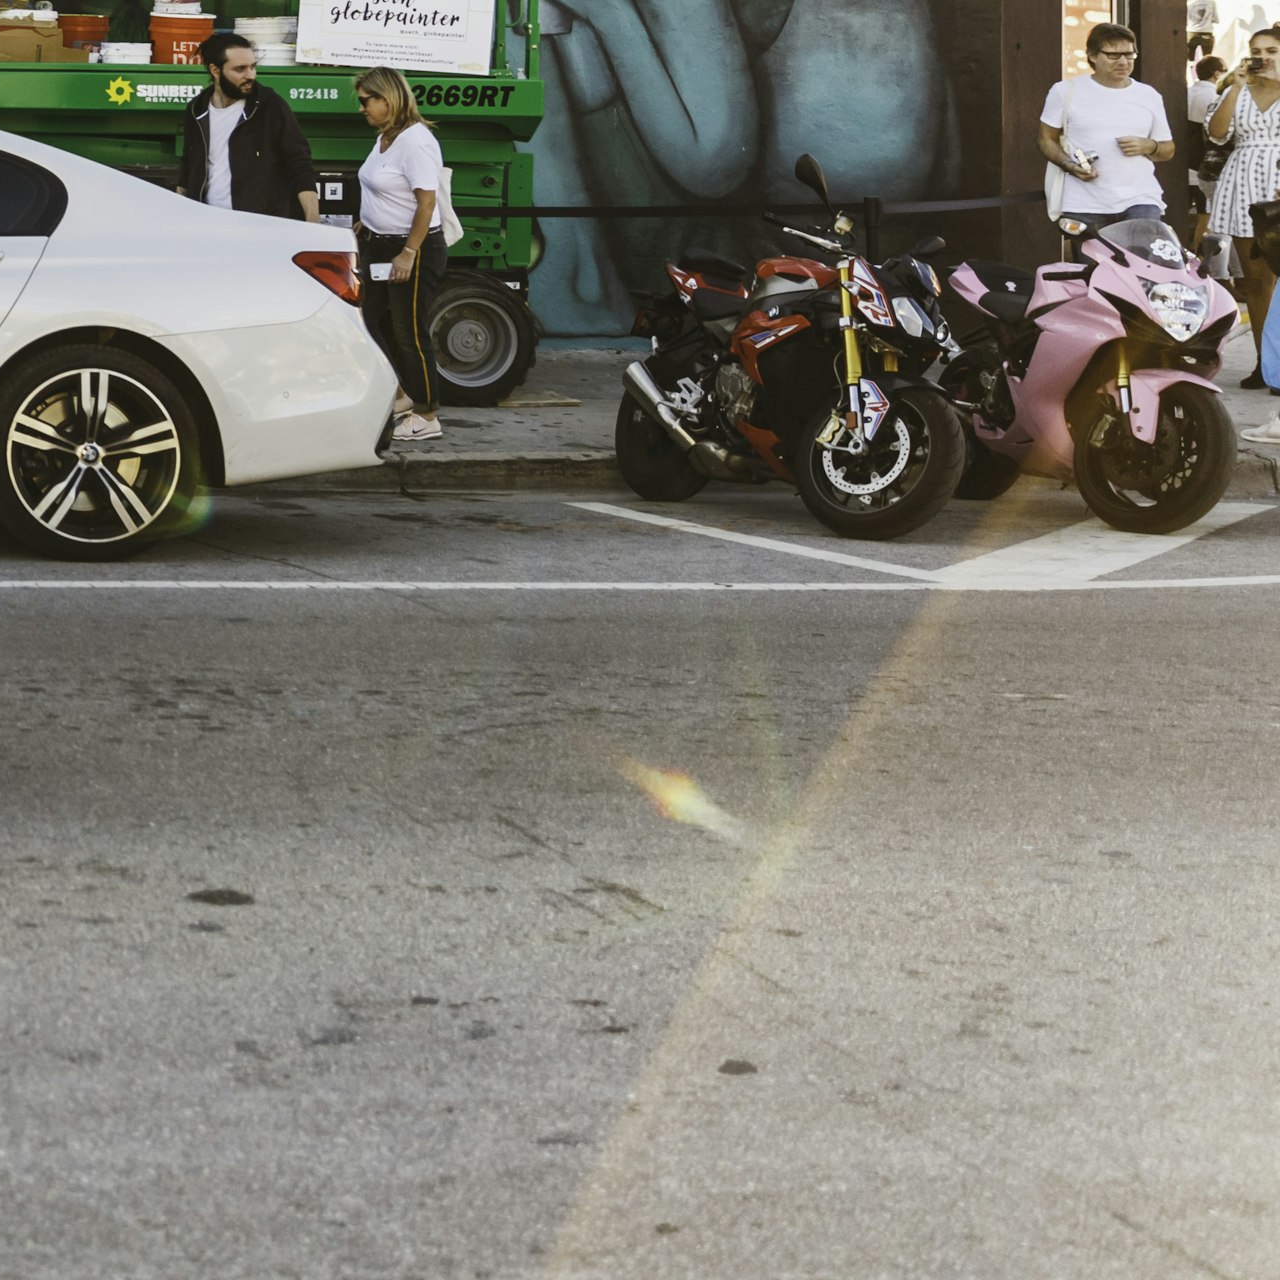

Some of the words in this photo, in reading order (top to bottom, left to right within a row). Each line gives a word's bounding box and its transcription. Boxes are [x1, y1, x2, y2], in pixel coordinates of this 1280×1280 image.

[331, 1, 460, 27] globepainter
[136, 84, 203, 98] SUNBELT
[290, 88, 338, 100] 972418
[411, 85, 516, 108] 2669RT
